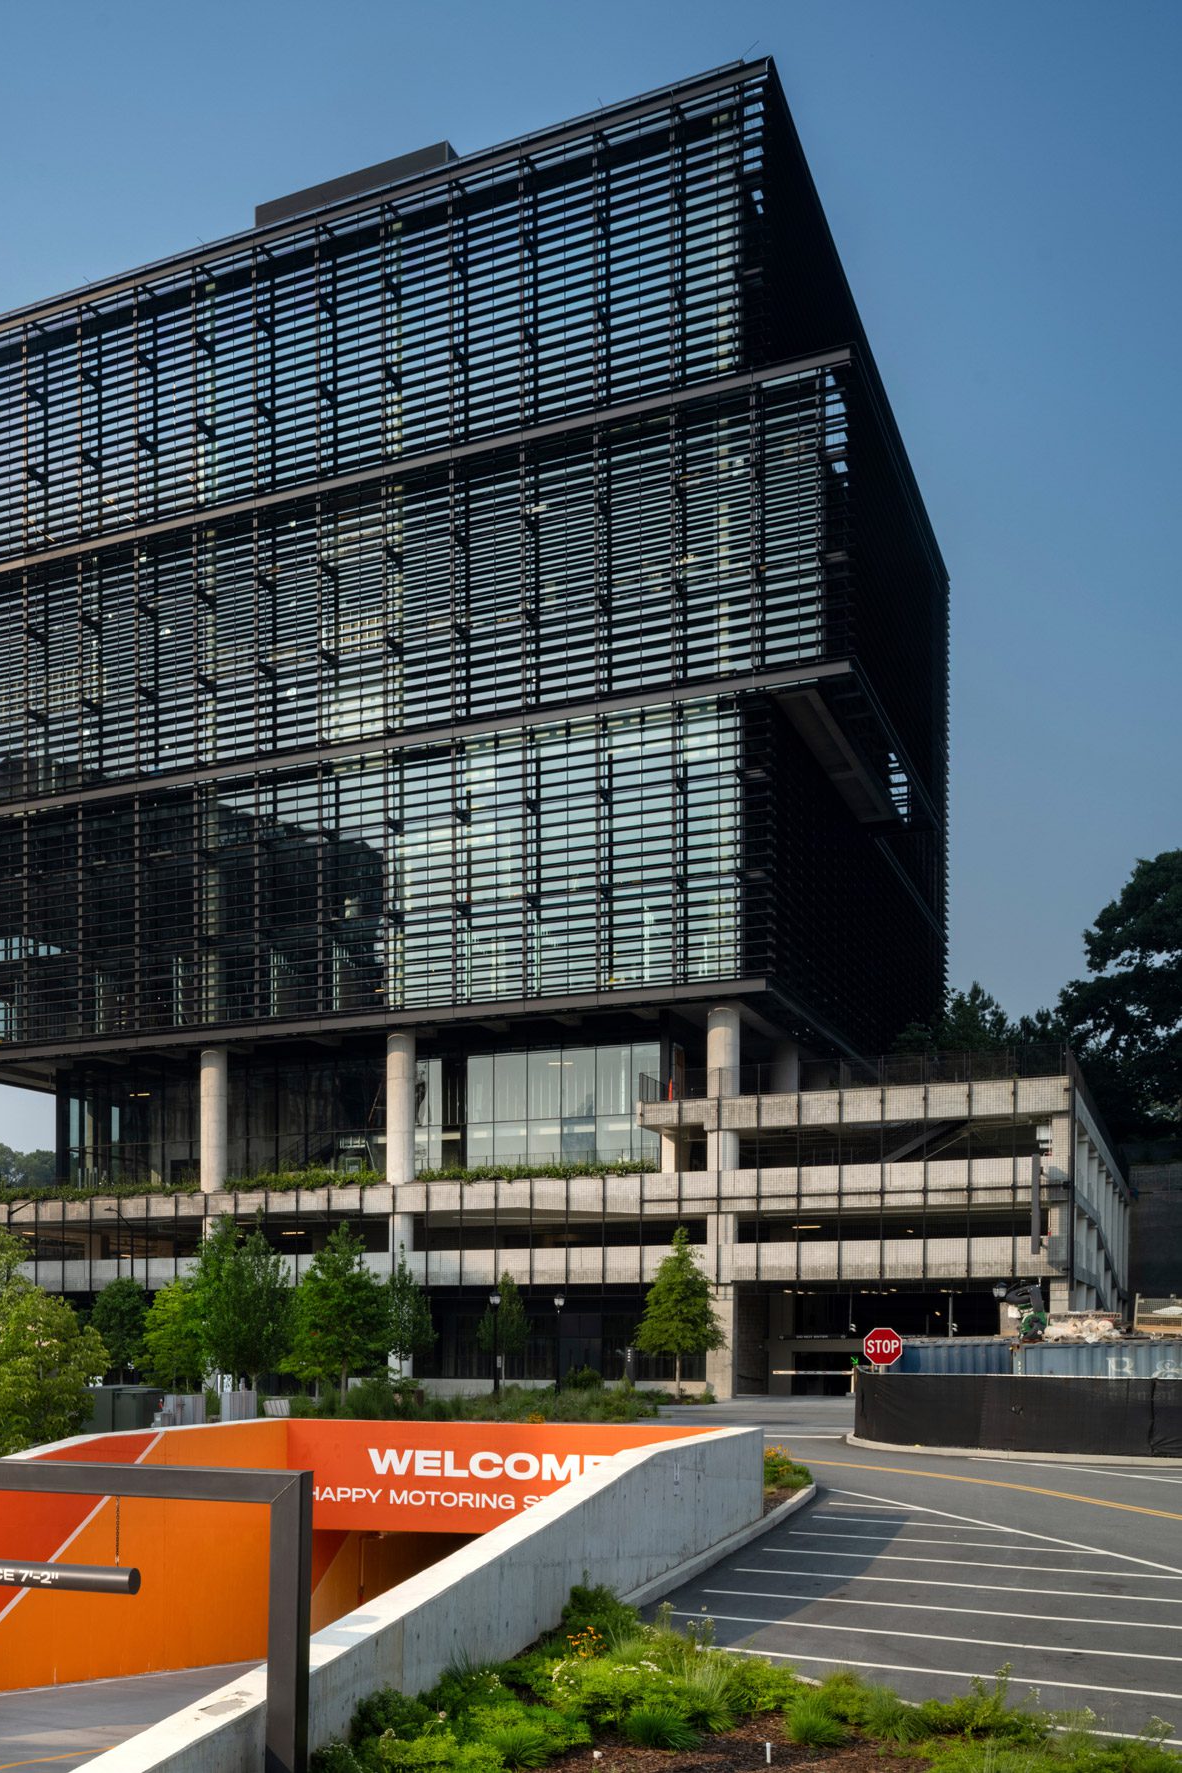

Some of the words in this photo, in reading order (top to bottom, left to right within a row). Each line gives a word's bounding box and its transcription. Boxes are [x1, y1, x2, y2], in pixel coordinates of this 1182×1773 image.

[867, 1339, 899, 1354] STOP
[389, 1489, 516, 1510] MOTORING
[523, 1494, 548, 1510] S
